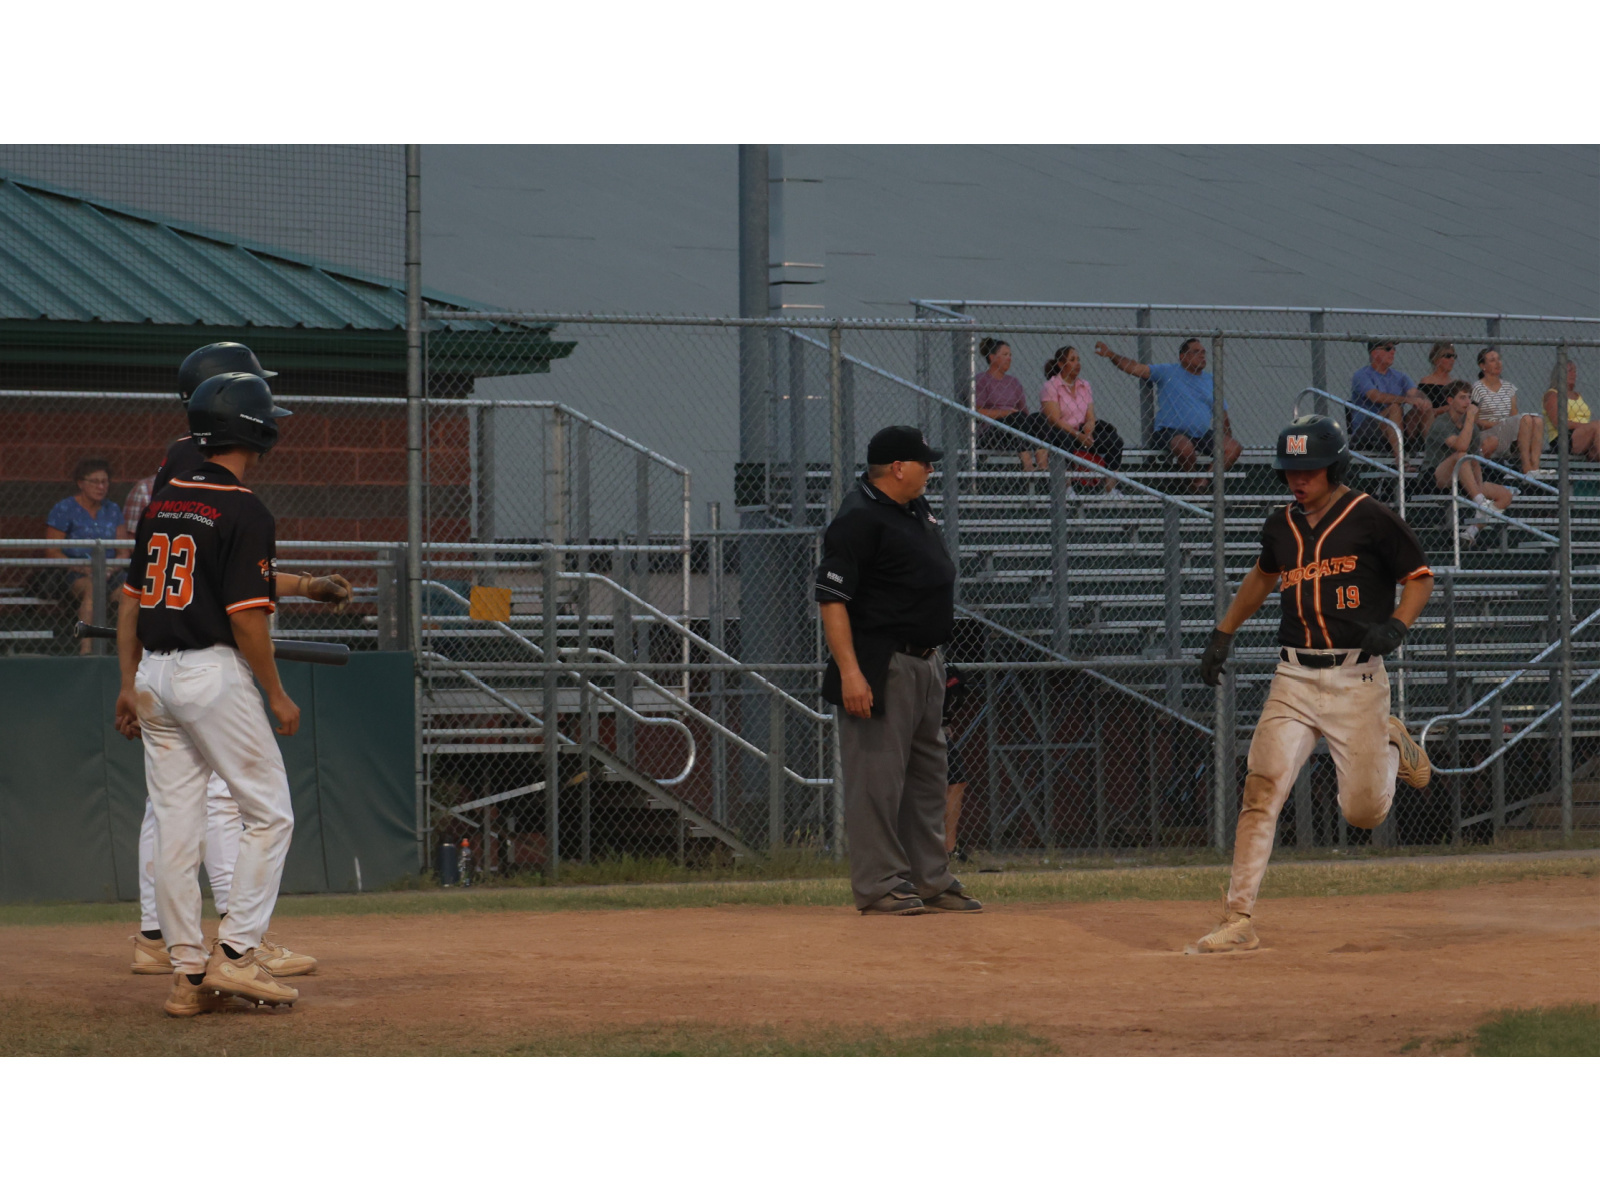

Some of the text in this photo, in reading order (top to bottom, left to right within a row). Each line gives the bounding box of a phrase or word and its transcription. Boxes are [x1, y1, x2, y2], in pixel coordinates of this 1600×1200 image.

[160, 500, 222, 520] MONCTON
[139, 532, 197, 611] 33
[1279, 555, 1358, 592] UDCATS
[1336, 585, 1360, 609] 19
